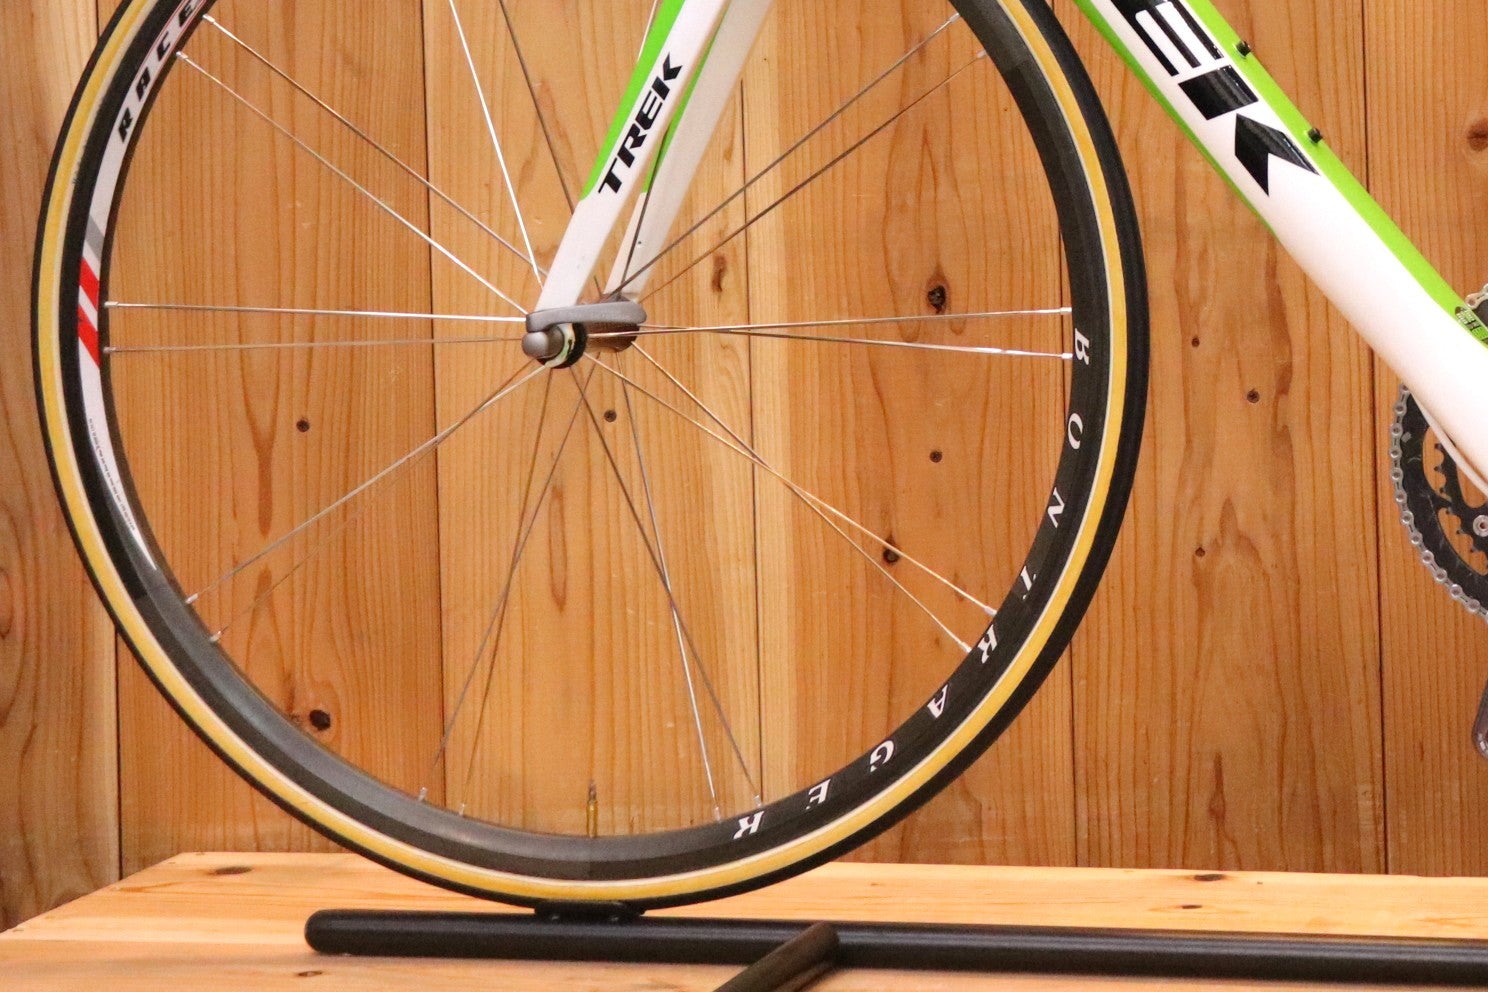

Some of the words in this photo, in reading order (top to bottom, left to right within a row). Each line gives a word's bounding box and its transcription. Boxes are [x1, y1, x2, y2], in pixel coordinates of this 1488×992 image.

[118, 5, 195, 143] RACE
[598, 52, 683, 194] TREK
[733, 327, 1090, 840] BONTRAGER
